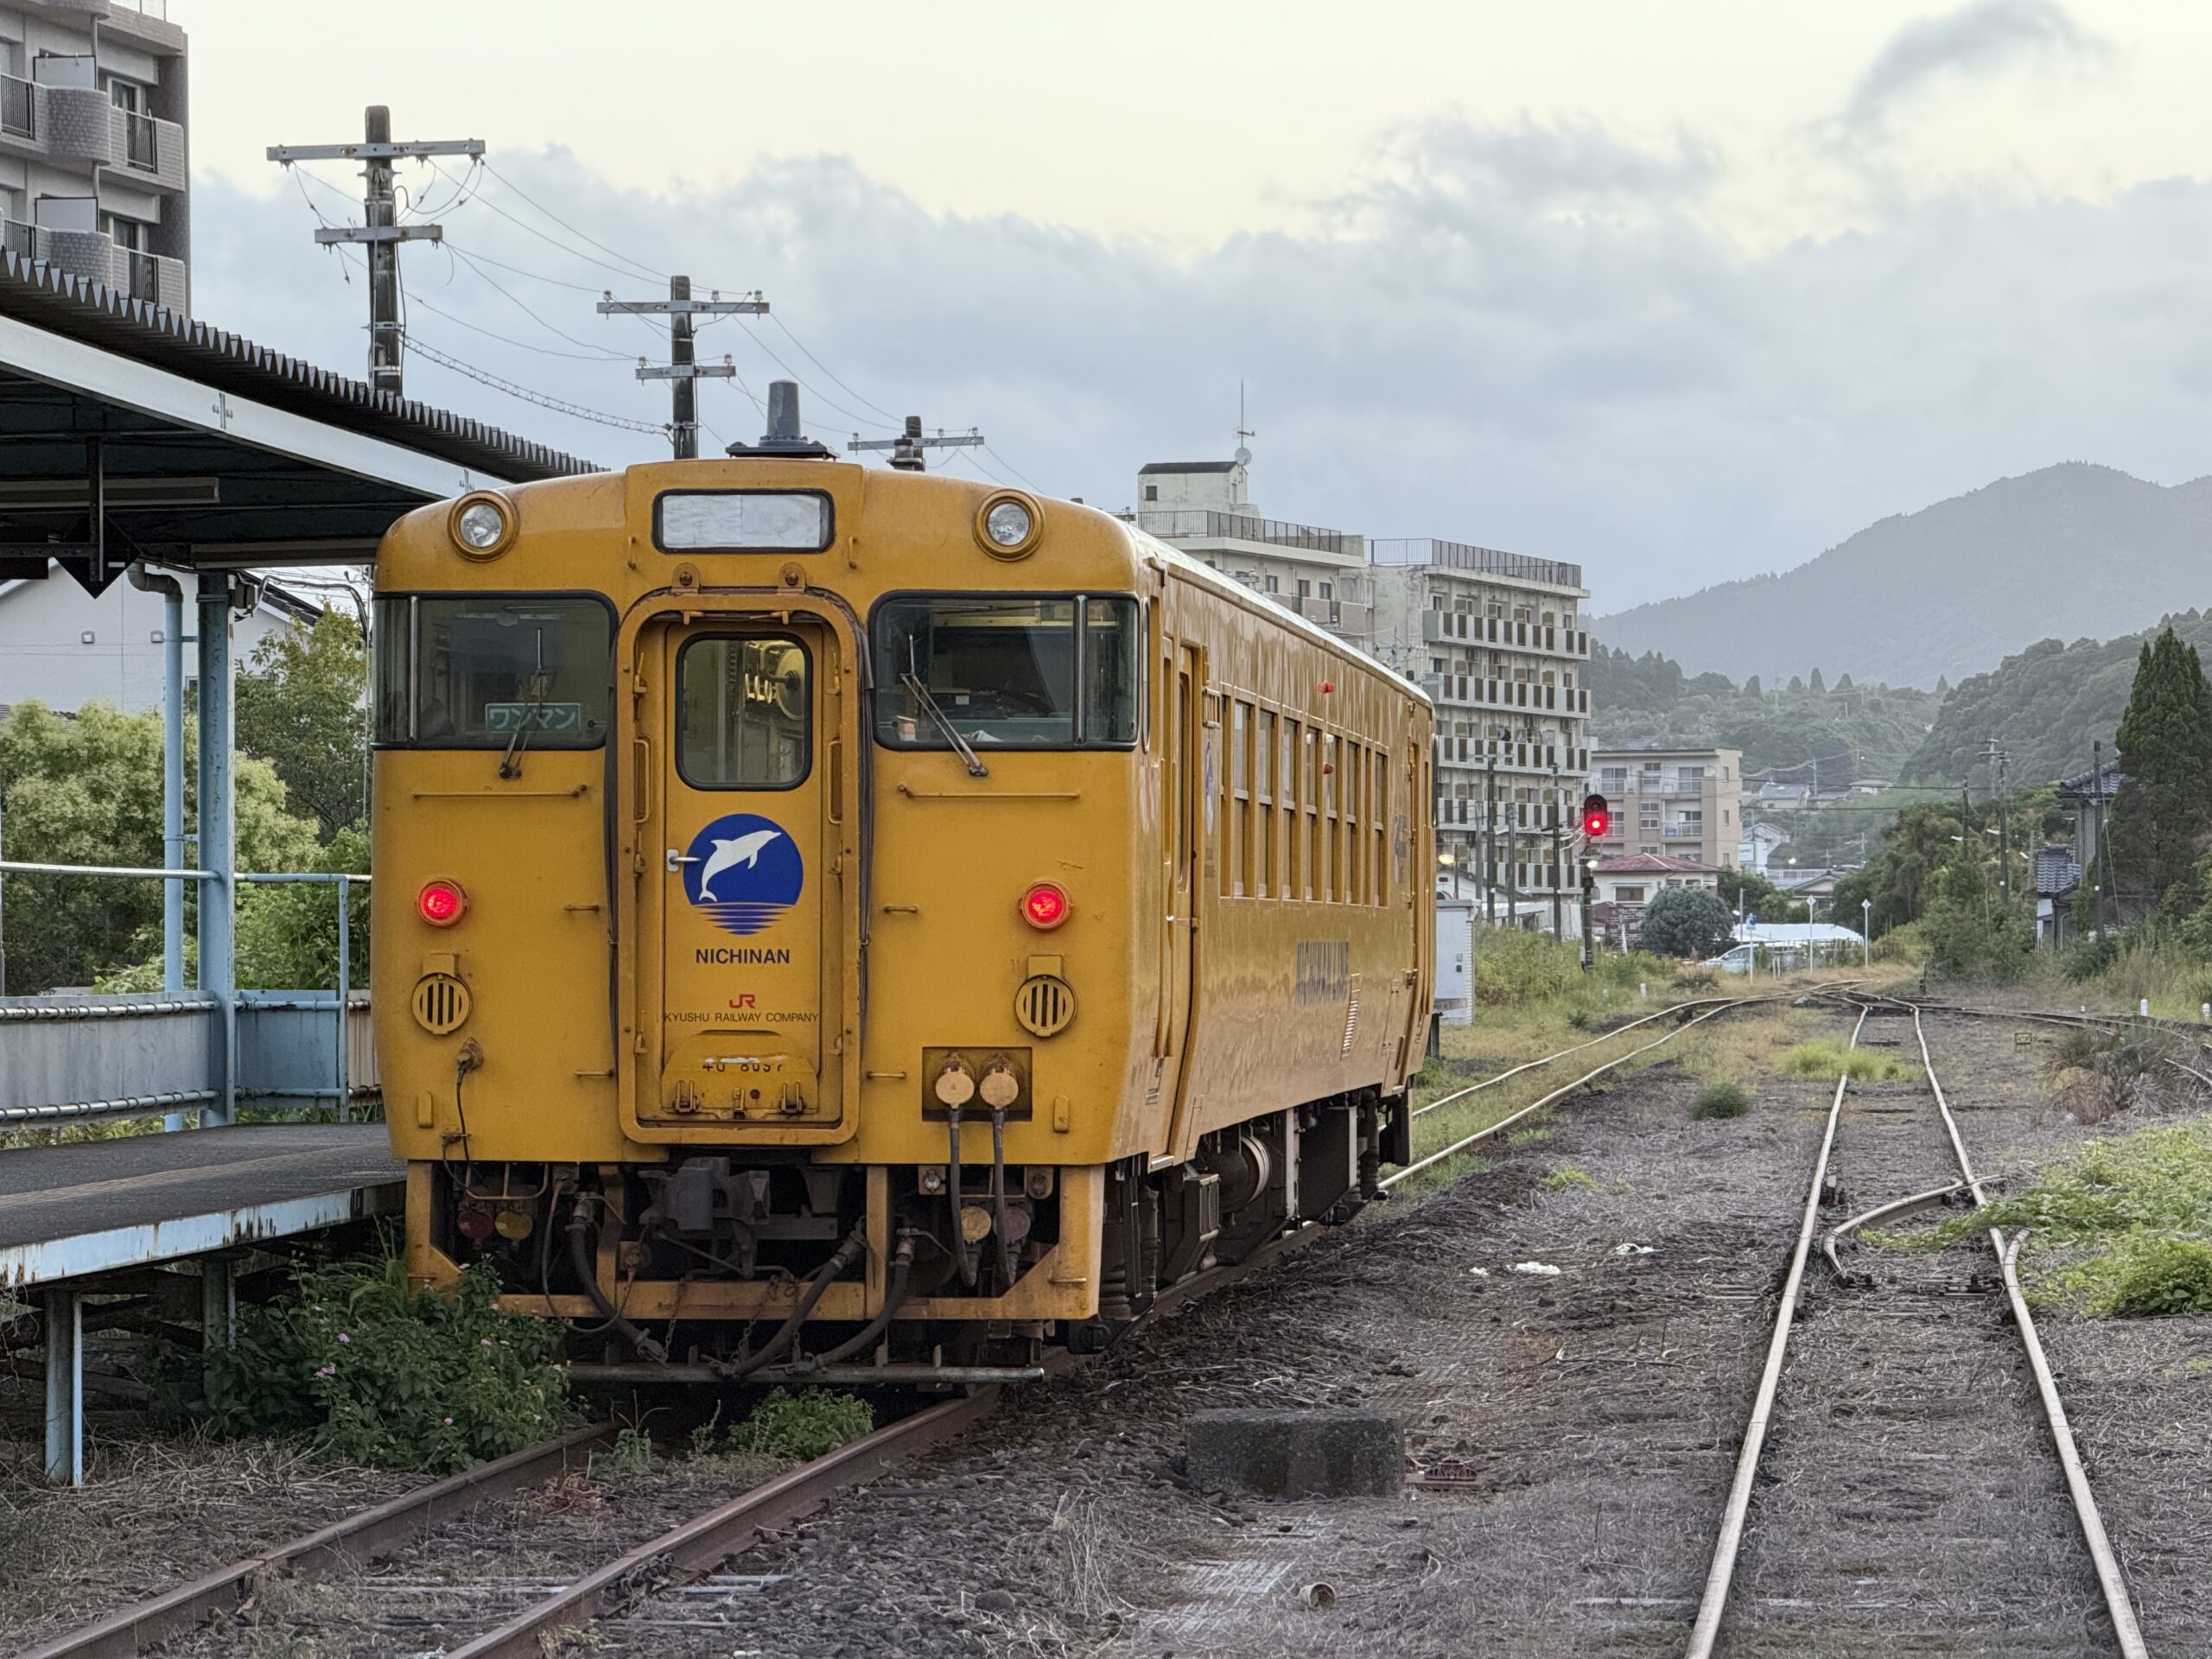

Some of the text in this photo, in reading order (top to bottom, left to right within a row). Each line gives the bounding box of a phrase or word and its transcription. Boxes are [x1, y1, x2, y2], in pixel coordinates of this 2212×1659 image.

[490, 708, 575, 729] ワンマン
[696, 948, 790, 964] NICHINAN
[729, 994, 755, 1009] JR
[664, 1013, 819, 1022] KYUSHU RAILWAY COMPANY
